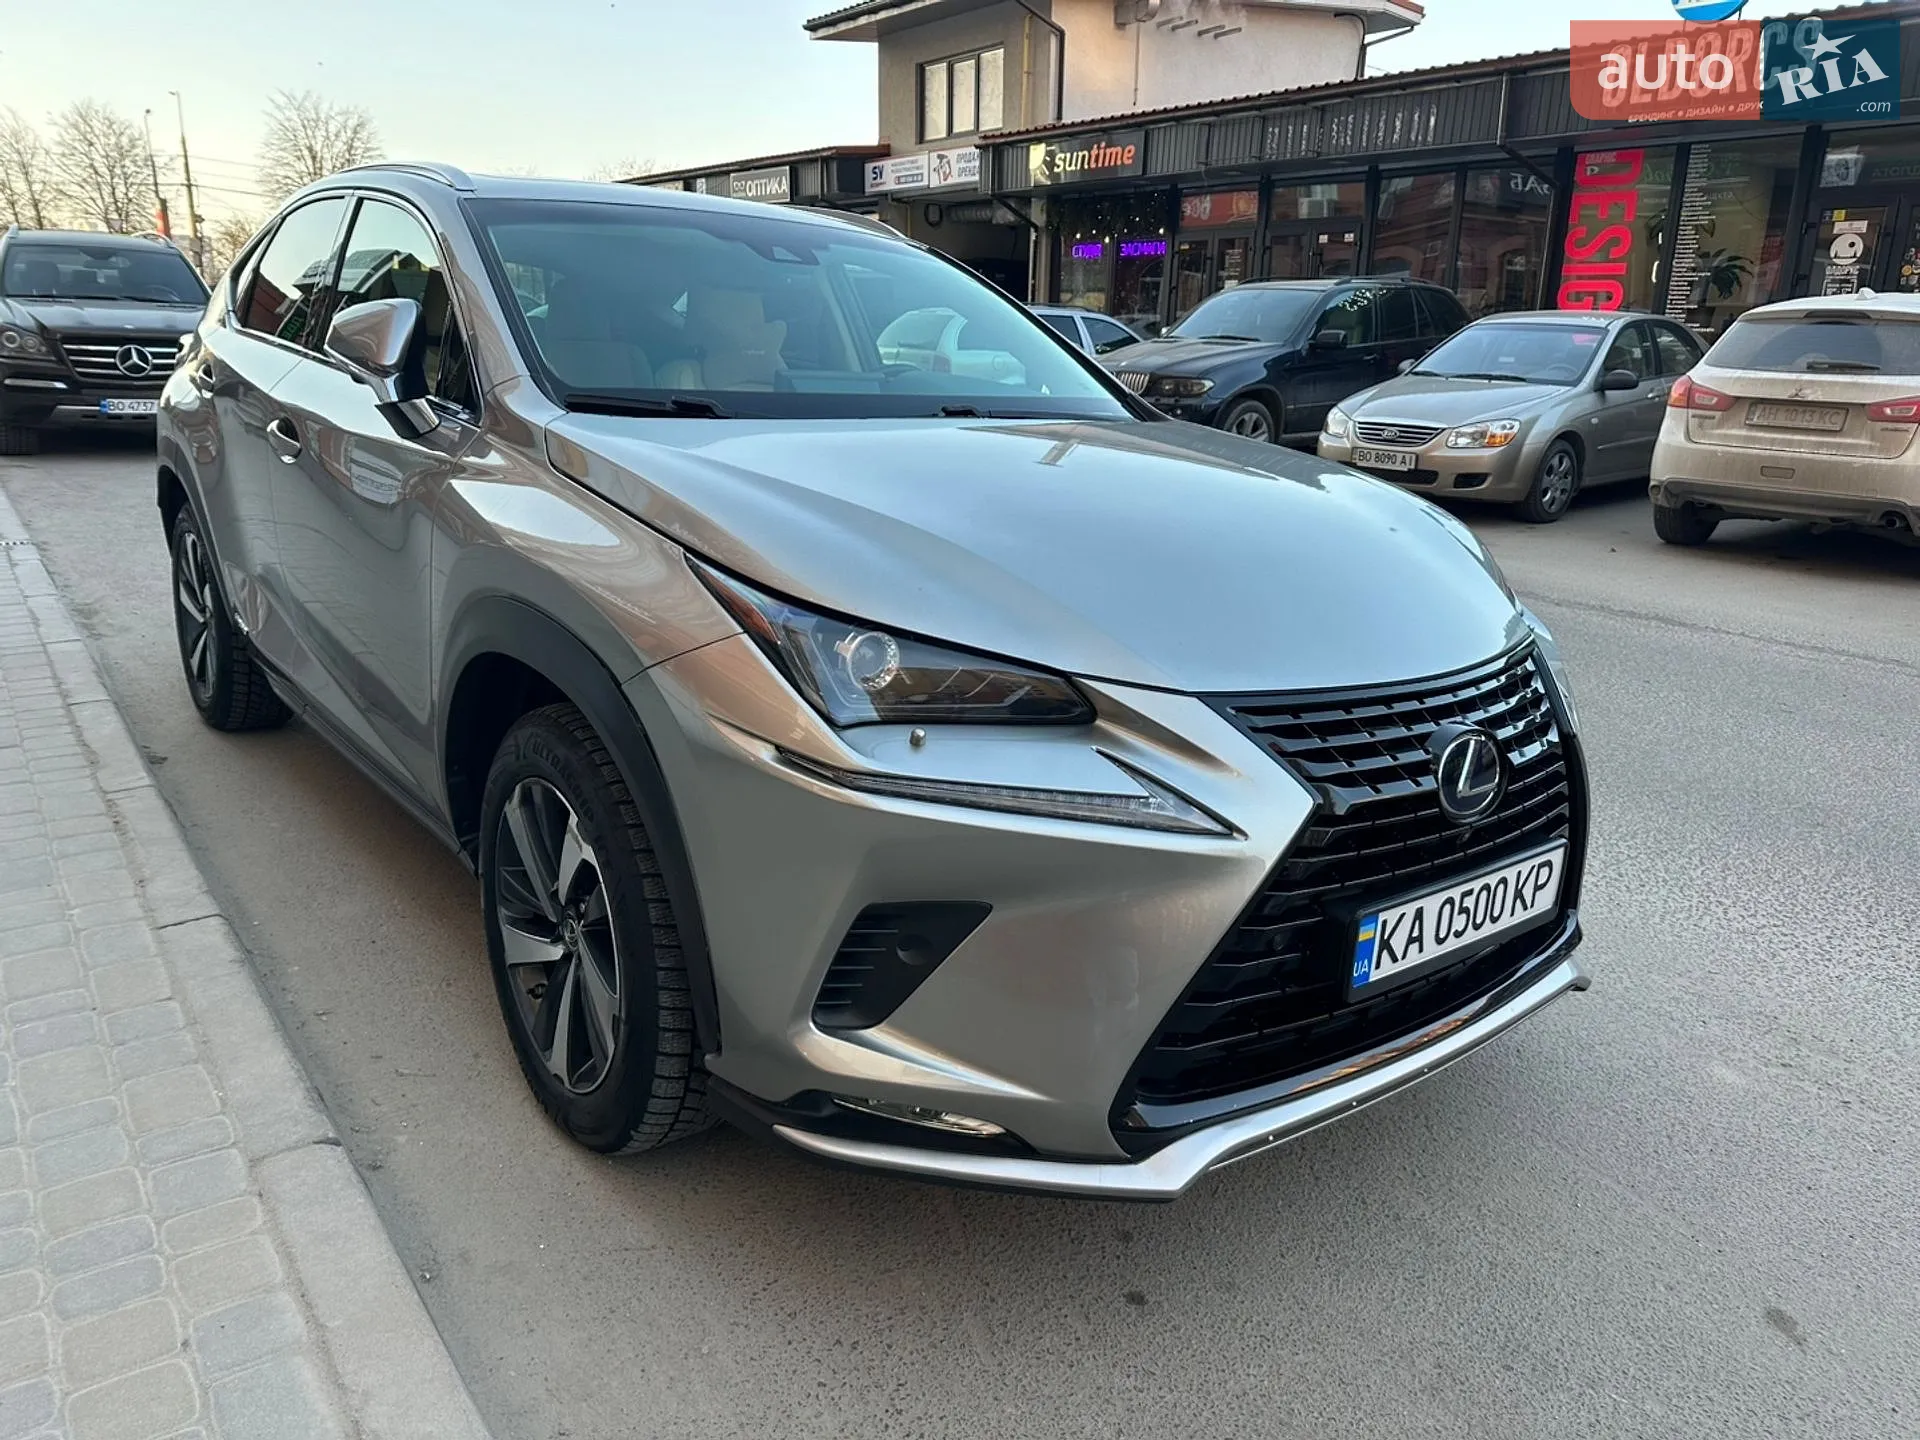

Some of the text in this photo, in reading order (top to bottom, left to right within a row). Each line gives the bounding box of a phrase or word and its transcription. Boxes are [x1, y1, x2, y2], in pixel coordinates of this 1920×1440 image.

[1053, 141, 1136, 173] suntime
[746, 175, 788, 197] ОПТИКА
[1358, 450, 1372, 462] BO
[1375, 858, 1554, 971] KA 0500 KP
[1353, 958, 1370, 978] UA
